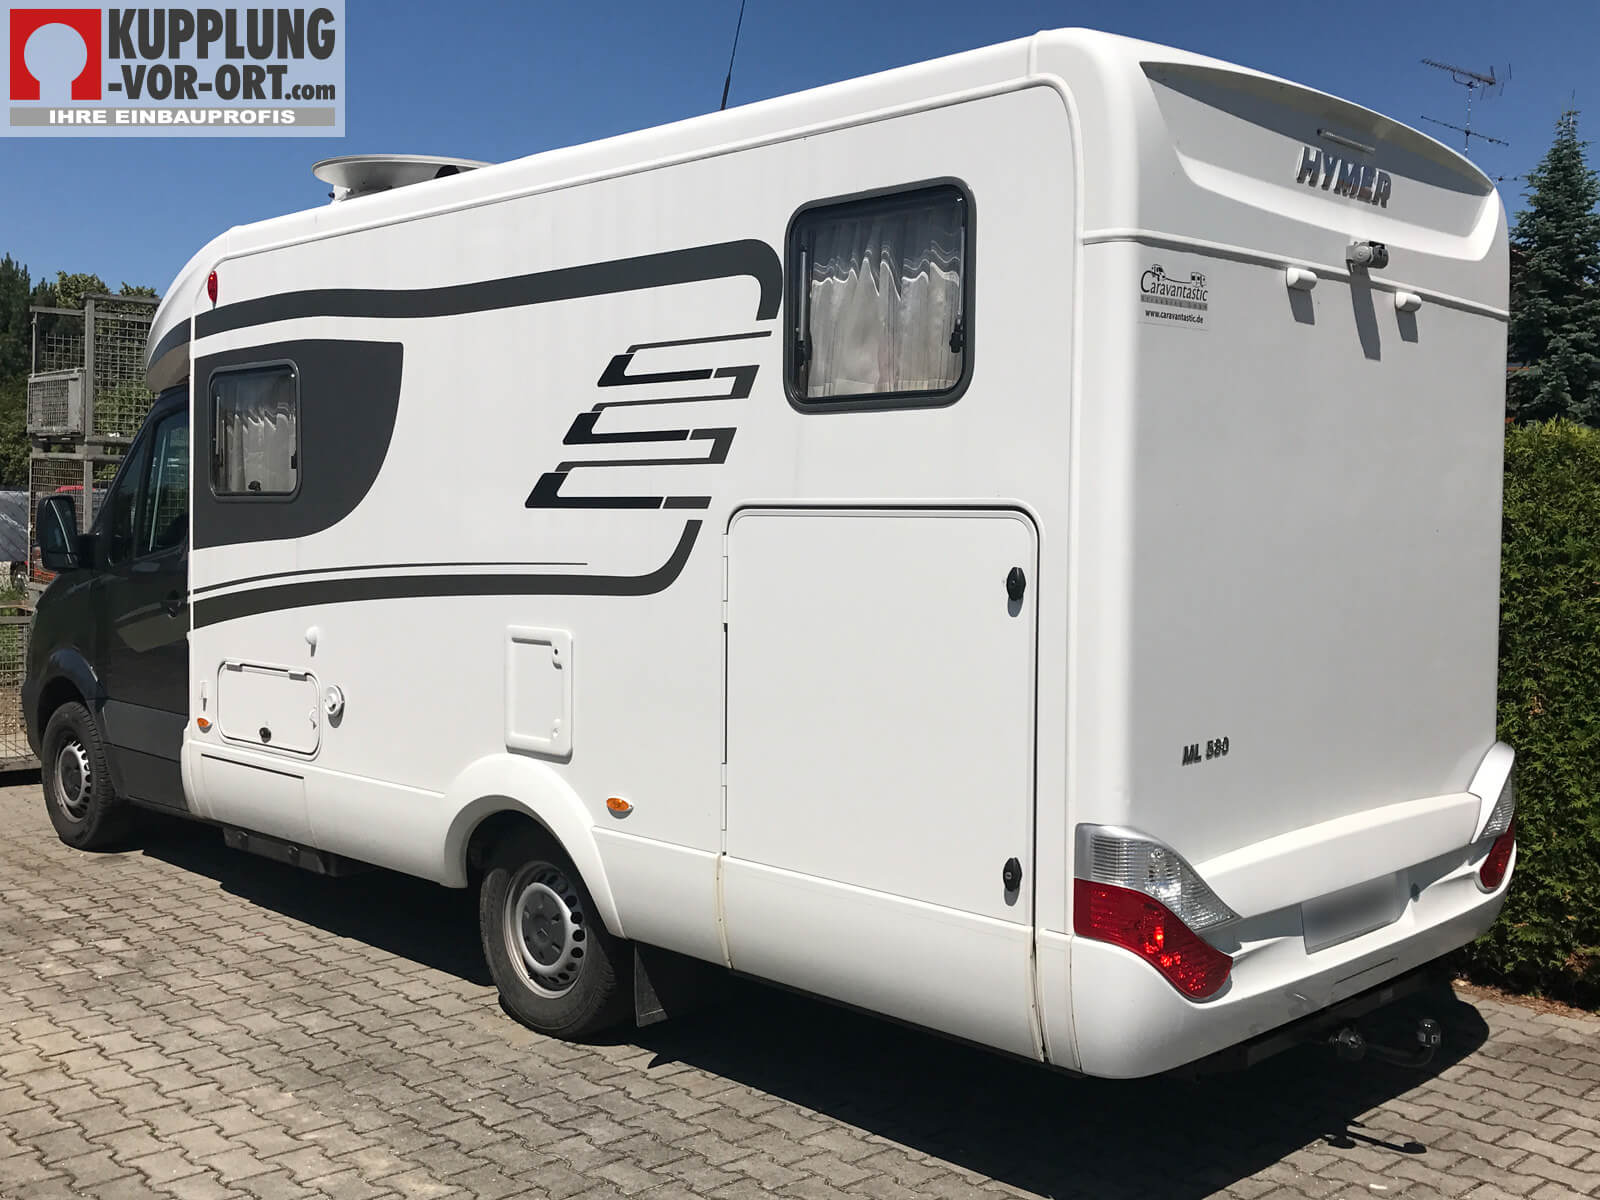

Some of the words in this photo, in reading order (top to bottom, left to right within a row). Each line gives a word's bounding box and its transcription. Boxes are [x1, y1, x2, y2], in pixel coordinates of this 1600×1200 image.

[1296, 145, 1392, 208] HYMER
[1140, 270, 1208, 302] Caravantastic
[1145, 309, 1204, 324] www.caravantastic.de
[1182, 743, 1202, 767] ML
